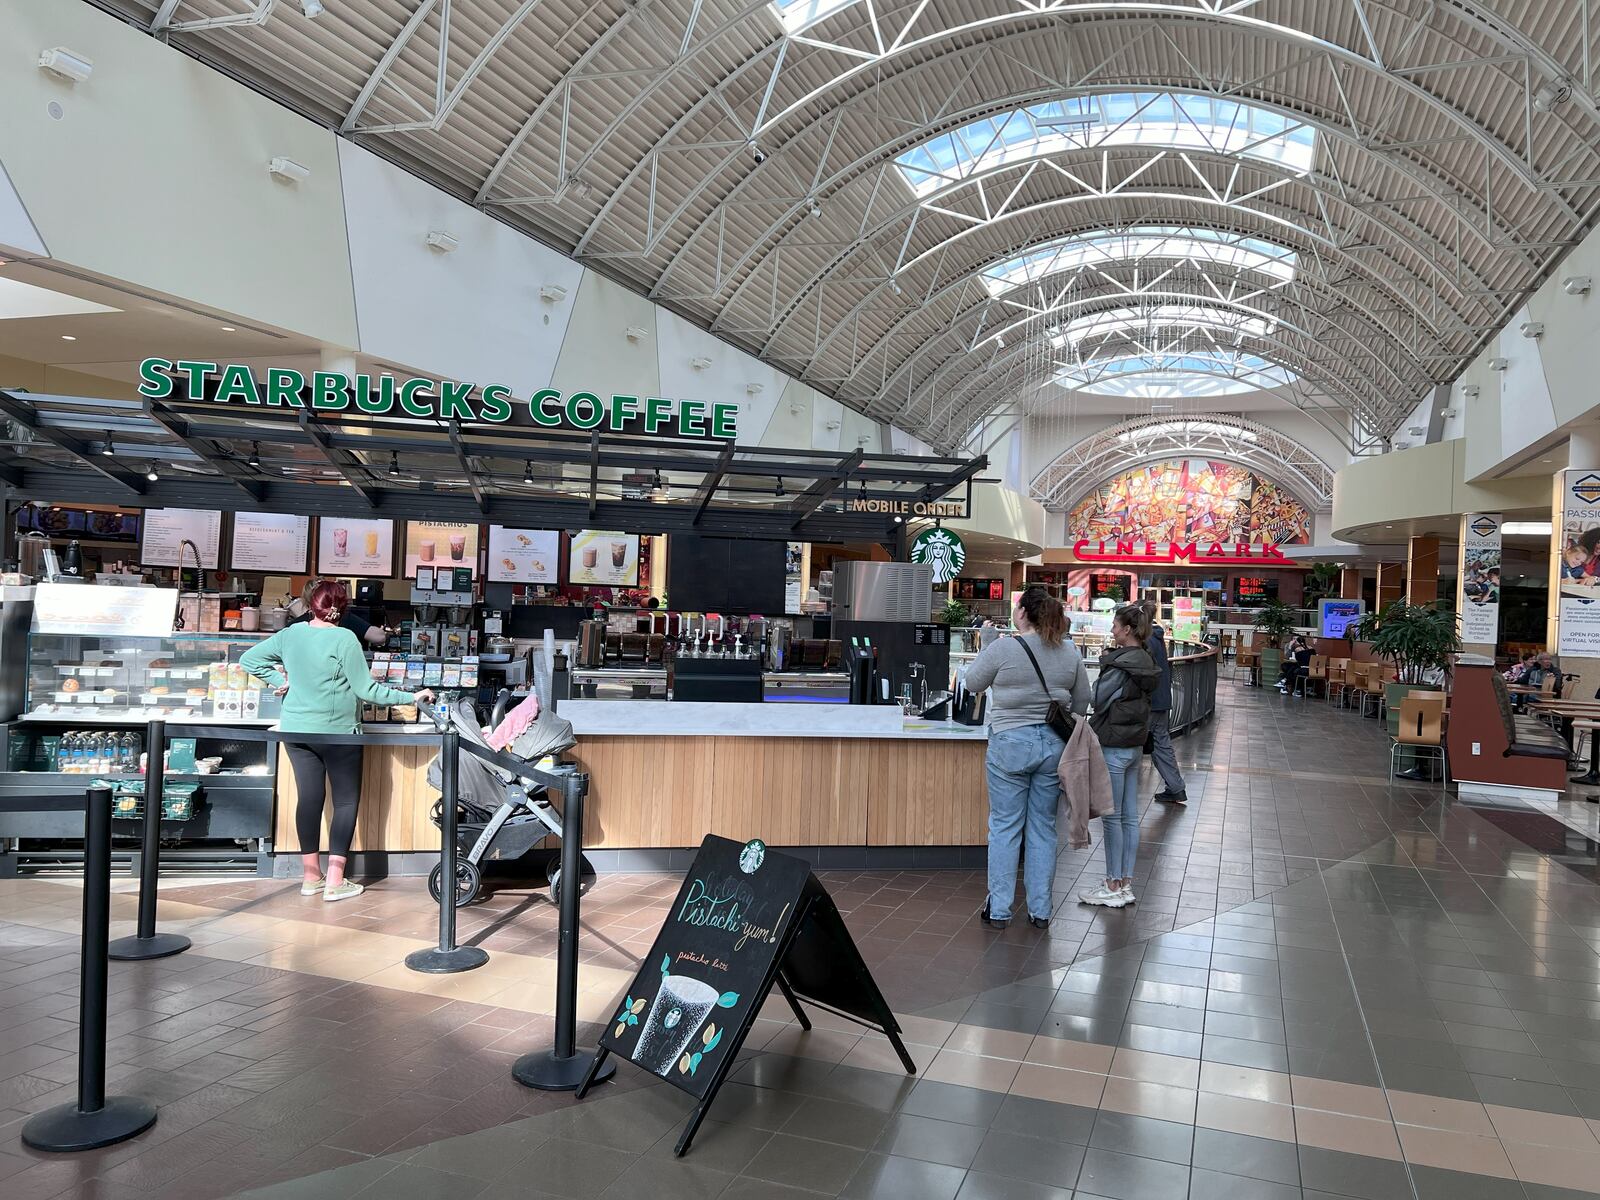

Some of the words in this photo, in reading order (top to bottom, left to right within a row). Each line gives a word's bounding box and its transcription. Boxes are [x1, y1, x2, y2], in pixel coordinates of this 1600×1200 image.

[137, 357, 512, 422] STARBUCKS
[529, 388, 738, 438] COFFEE
[853, 499, 909, 514] MOBILE
[913, 502, 963, 516] ORDER
[1567, 509, 1600, 518] PASSI
[1073, 540, 1286, 563] CINEMARK
[473, 828, 494, 860] BRAVO
